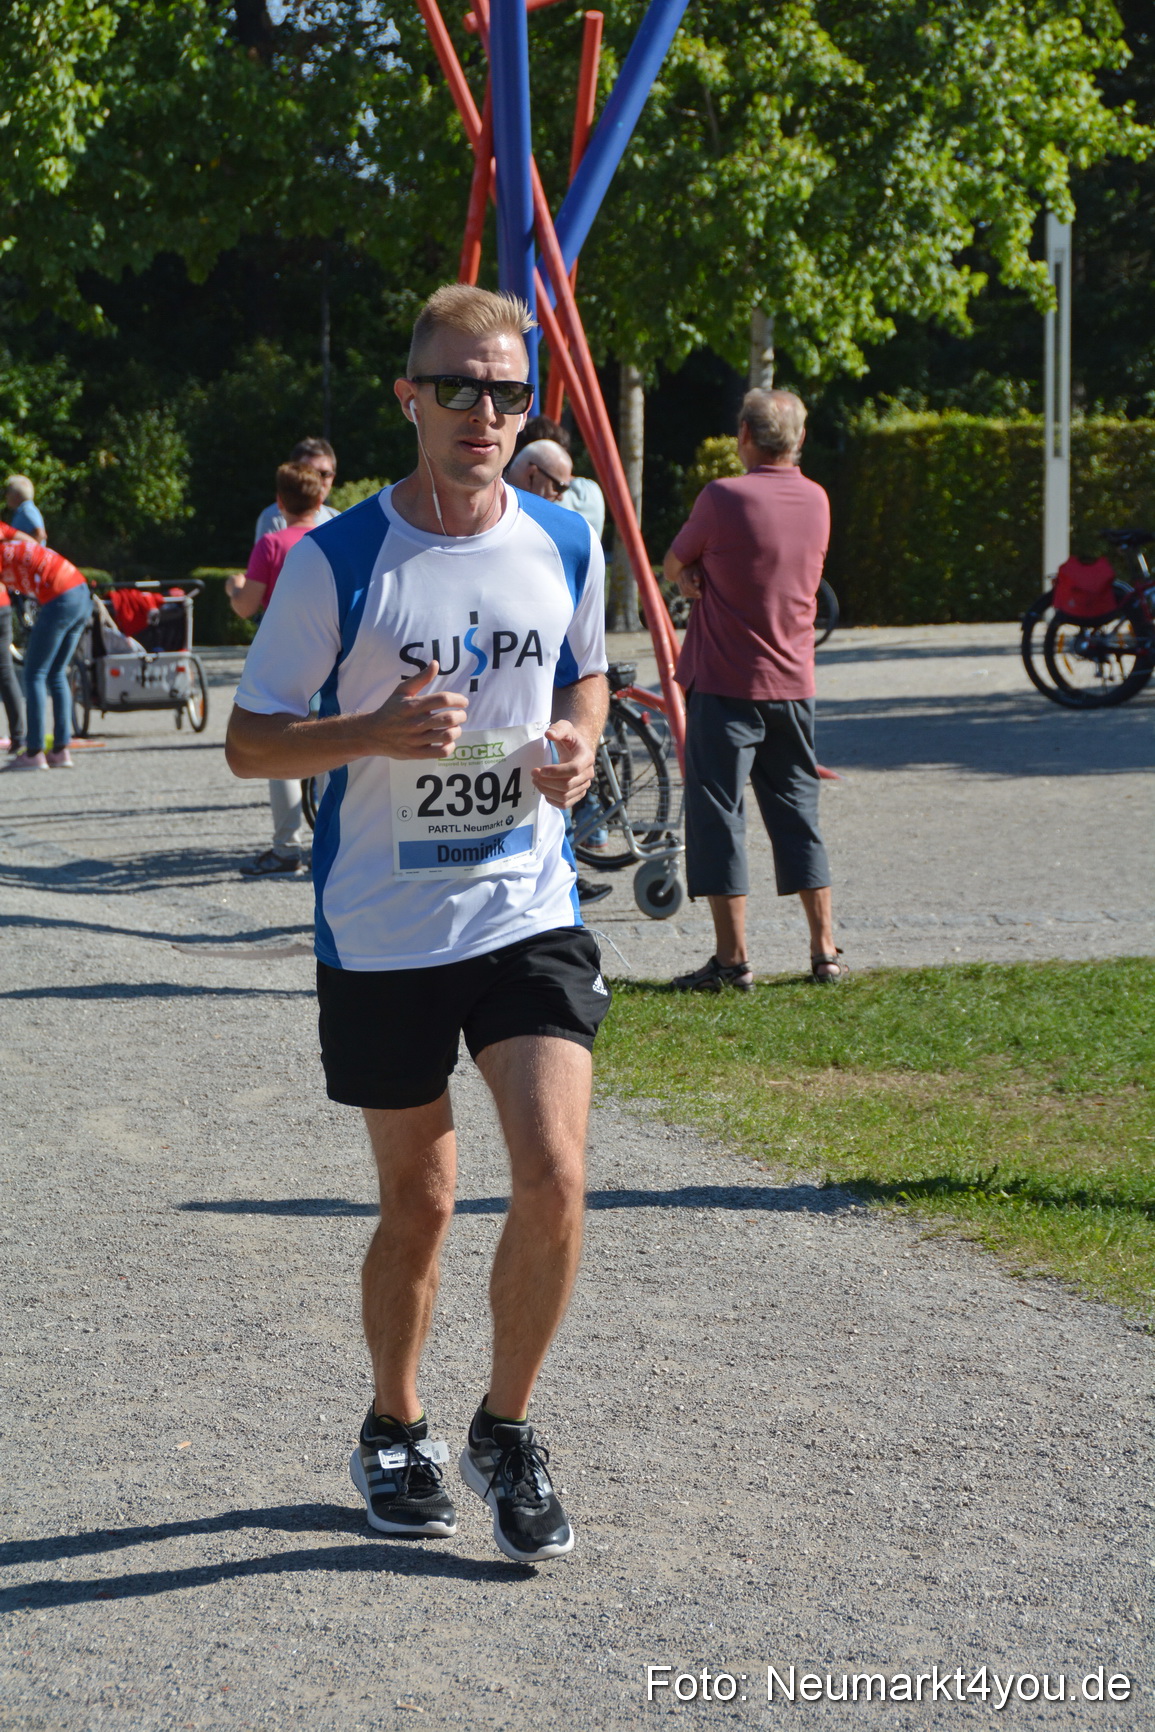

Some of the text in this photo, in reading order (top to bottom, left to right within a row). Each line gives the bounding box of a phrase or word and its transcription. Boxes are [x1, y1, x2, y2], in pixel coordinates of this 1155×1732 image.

[399, 627, 543, 681] SUSPA
[416, 767, 522, 817] 2394
[428, 819, 503, 833] PARTL Neumarkt
[437, 839, 505, 863] Dominik
